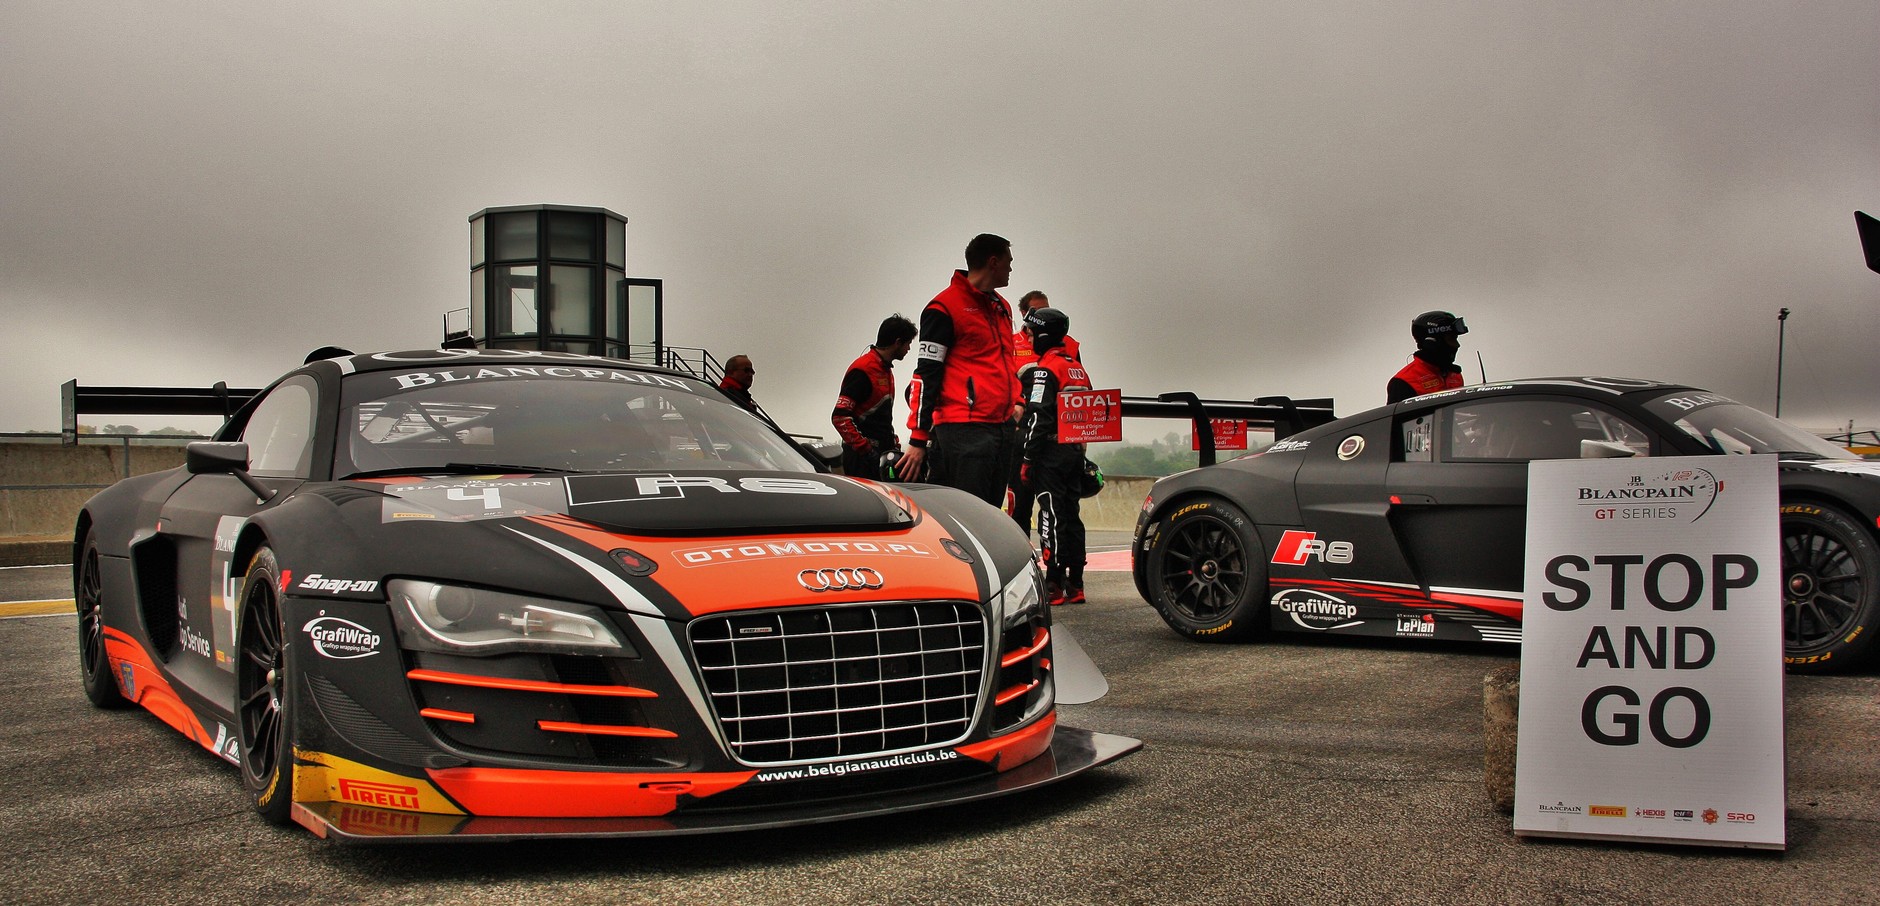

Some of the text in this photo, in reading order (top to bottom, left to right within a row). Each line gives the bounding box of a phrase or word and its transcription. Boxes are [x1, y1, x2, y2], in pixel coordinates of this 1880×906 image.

[1028, 315, 1047, 327] uvex
[1427, 325, 1453, 334] uvex
[919, 343, 939, 354] RO
[391, 367, 693, 392] BLANCPAIN
[1060, 393, 1117, 408] TOTAL
[395, 481, 552, 492] BLANCPAIN
[1578, 485, 1695, 500] BLANCPAIN
[447, 488, 501, 509] 4
[1595, 507, 1677, 519] GT SERIES
[1780, 505, 1822, 515] RELLI
[684, 541, 931, 563] OTOMOTO.PL
[1293, 539, 1354, 563] R8
[299, 573, 378, 594] Snap-on
[1542, 553, 1759, 612] STOP
[1279, 598, 1357, 619] GrafiWrap
[1196, 619, 1233, 635] PIRELLI
[1397, 618, 1435, 632] LePlan
[187, 625, 211, 658] Service
[311, 625, 380, 649] GrafiWrap
[1576, 625, 1716, 670] AND
[1784, 651, 1832, 665] PZER
[1581, 685, 1711, 748] GO
[757, 750, 958, 782] www.belgianaudiclub.be
[339, 778, 420, 809] PIRELLI
[1727, 812, 1755, 821] SRO
